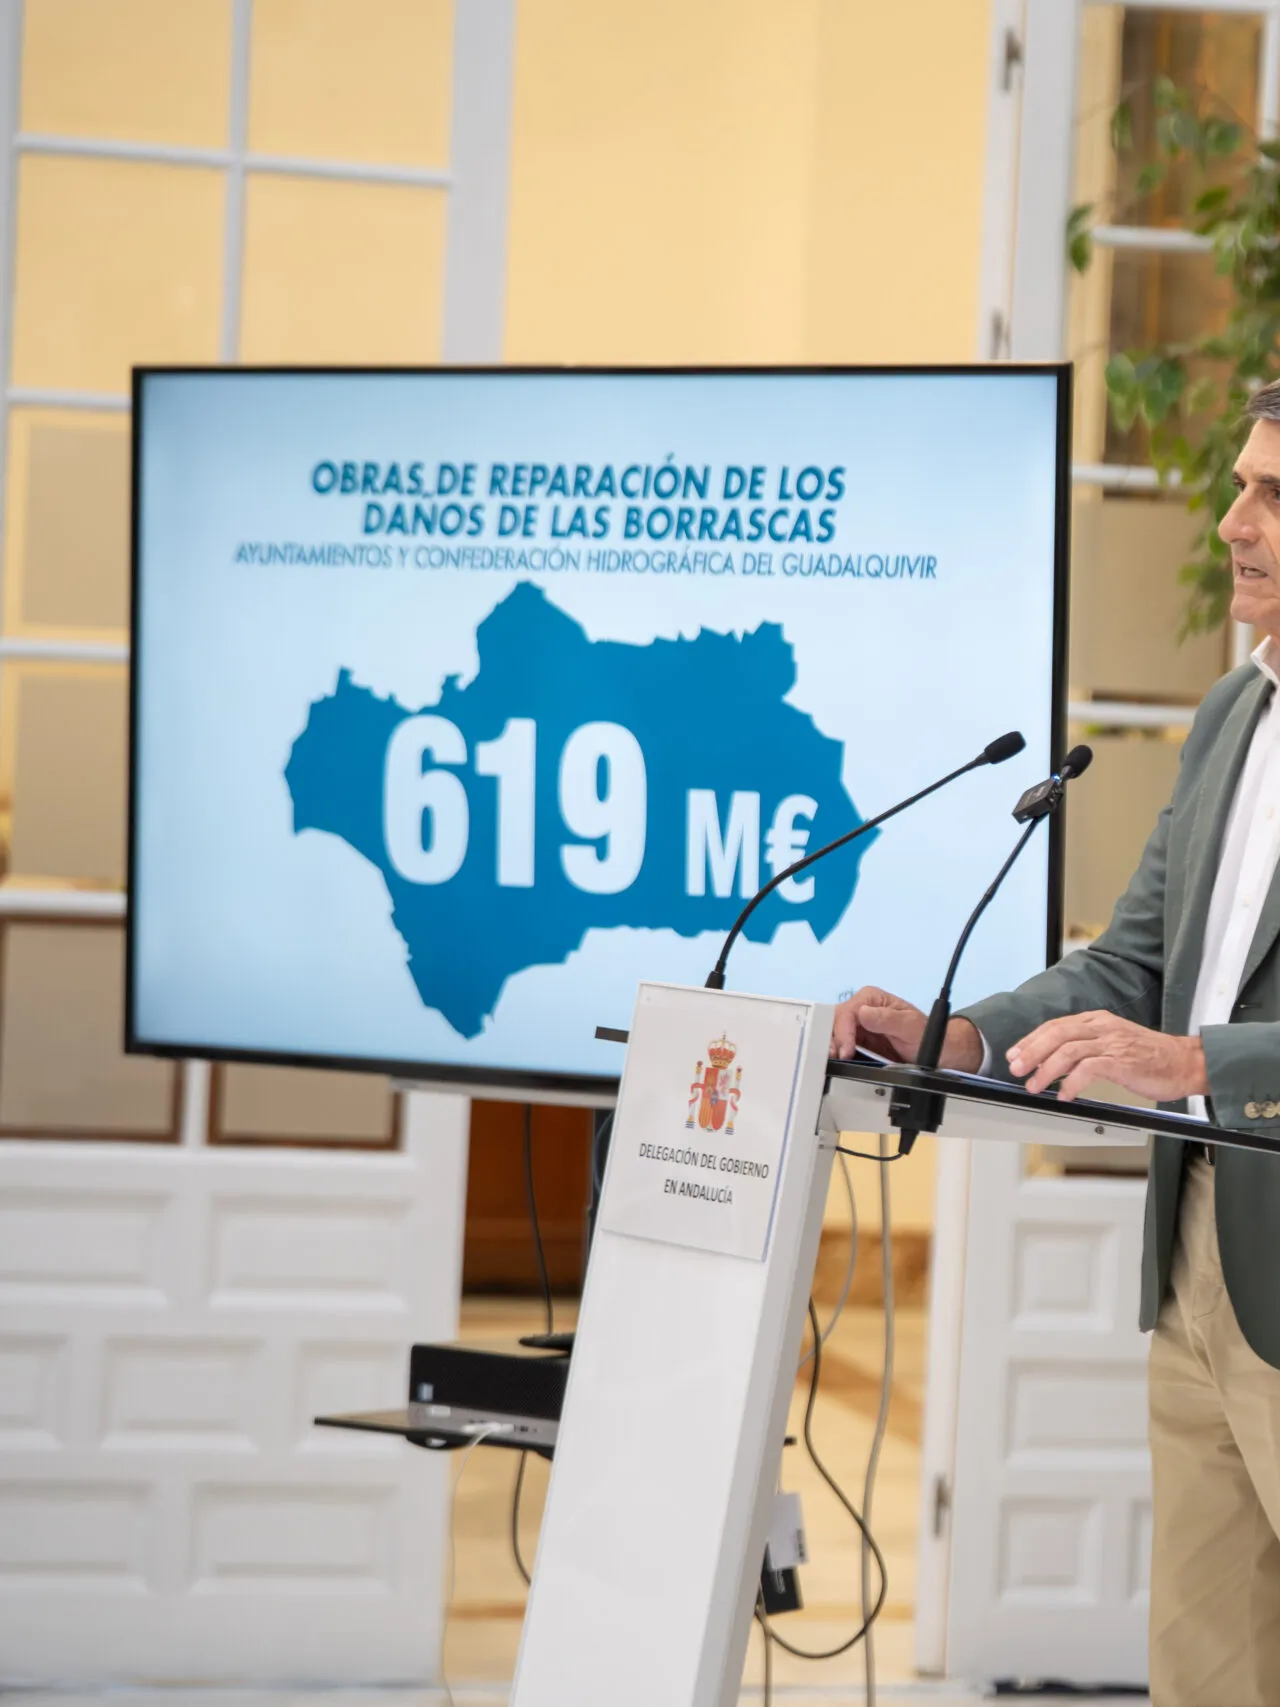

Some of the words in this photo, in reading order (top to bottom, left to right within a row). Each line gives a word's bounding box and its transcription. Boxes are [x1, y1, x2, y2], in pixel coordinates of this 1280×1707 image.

[312, 461, 424, 496] OBRAS
[437, 462, 477, 497] DE
[489, 452, 711, 499] REPARACIÓN
[723, 465, 767, 500] DE
[778, 465, 846, 501] LOS
[364, 493, 485, 537] DAÑOS
[498, 503, 539, 538] DE
[550, 504, 611, 540] LAS
[623, 505, 837, 543] BORRASCAS
[234, 541, 392, 568] AYUNTAMIENTOS
[399, 546, 410, 568] Y
[415, 543, 580, 572] CONFEDERACIÓN
[587, 545, 734, 575] HIDROGRÁFICA
[742, 552, 775, 576] DEL
[782, 551, 937, 579] GUADALQUIVIR
[384, 713, 648, 895] 619
[686, 787, 819, 903] M€
[639, 1142, 699, 1167] DELEGACIÓN
[700, 1153, 717, 1170] DEL
[719, 1157, 769, 1179] GOBIERNO
[664, 1179, 678, 1195] EN
[679, 1182, 733, 1205] ANDALUCÍA
